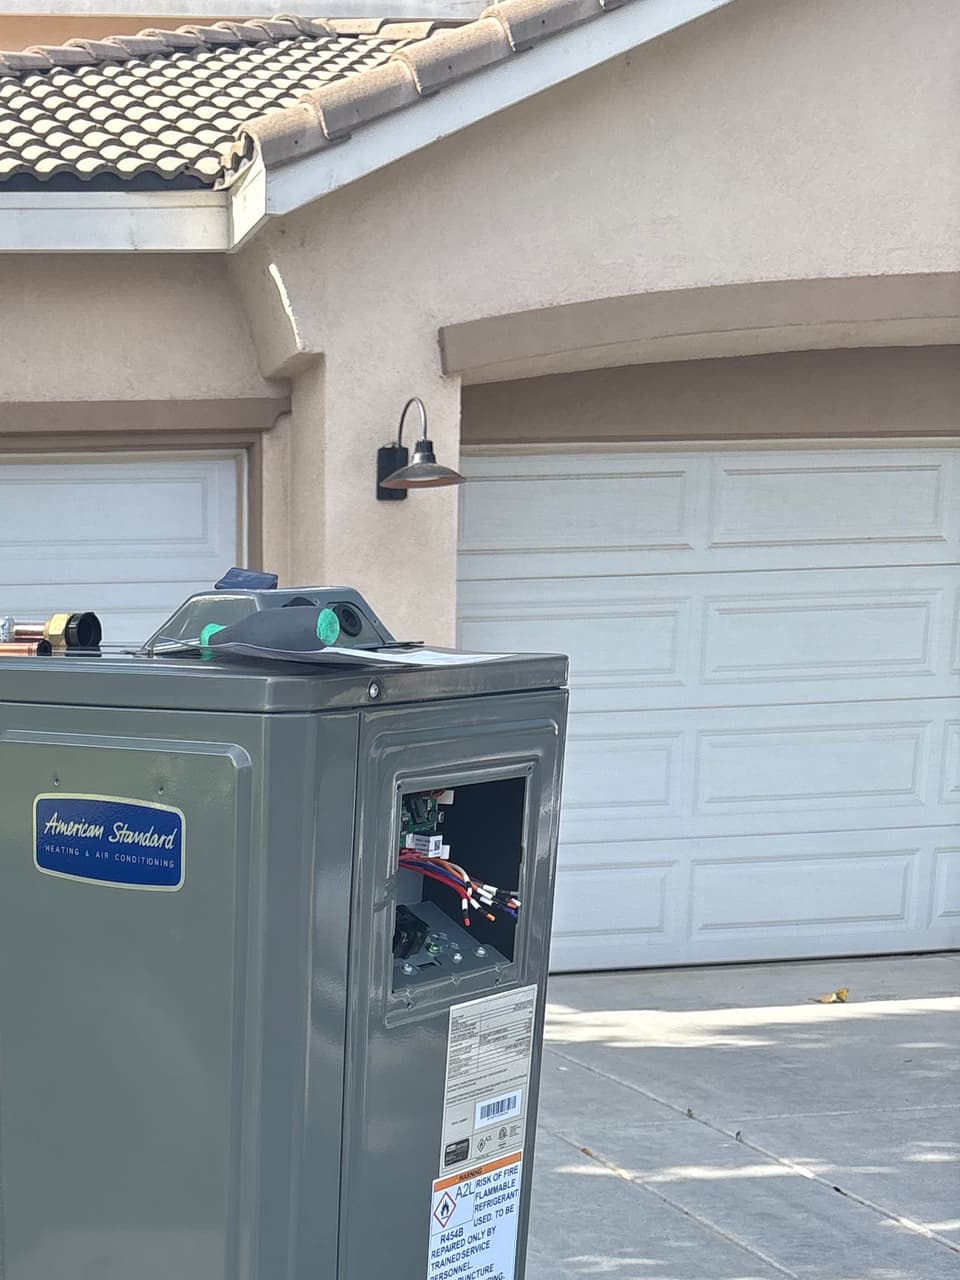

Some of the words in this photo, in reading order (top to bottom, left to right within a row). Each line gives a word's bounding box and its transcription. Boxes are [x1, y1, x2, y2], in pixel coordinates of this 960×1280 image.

[44, 811, 104, 839] American
[108, 822, 178, 850] Standard
[45, 844, 80, 856] HEATING
[95, 851, 109, 860] AIR
[114, 854, 175, 868] CONDITIONING
[475, 1176, 492, 1188] RISK
[493, 1172, 503, 1182] OF
[504, 1165, 519, 1177] FIRE
[455, 1182, 476, 1200] A2L
[474, 1178, 516, 1200] FLAMMABLE
[474, 1189, 519, 1212] REFRIGERANT
[495, 1208, 504, 1219] TO
[505, 1204, 515, 1215] BE
[431, 1238, 466, 1259] REPAIRED
[467, 1230, 486, 1244] ONLY
[487, 1225, 496, 1237] BY
[440, 1227, 464, 1244] R454B
[431, 1253, 461, 1271] TRAINED
[461, 1240, 491, 1260] SERVICE
